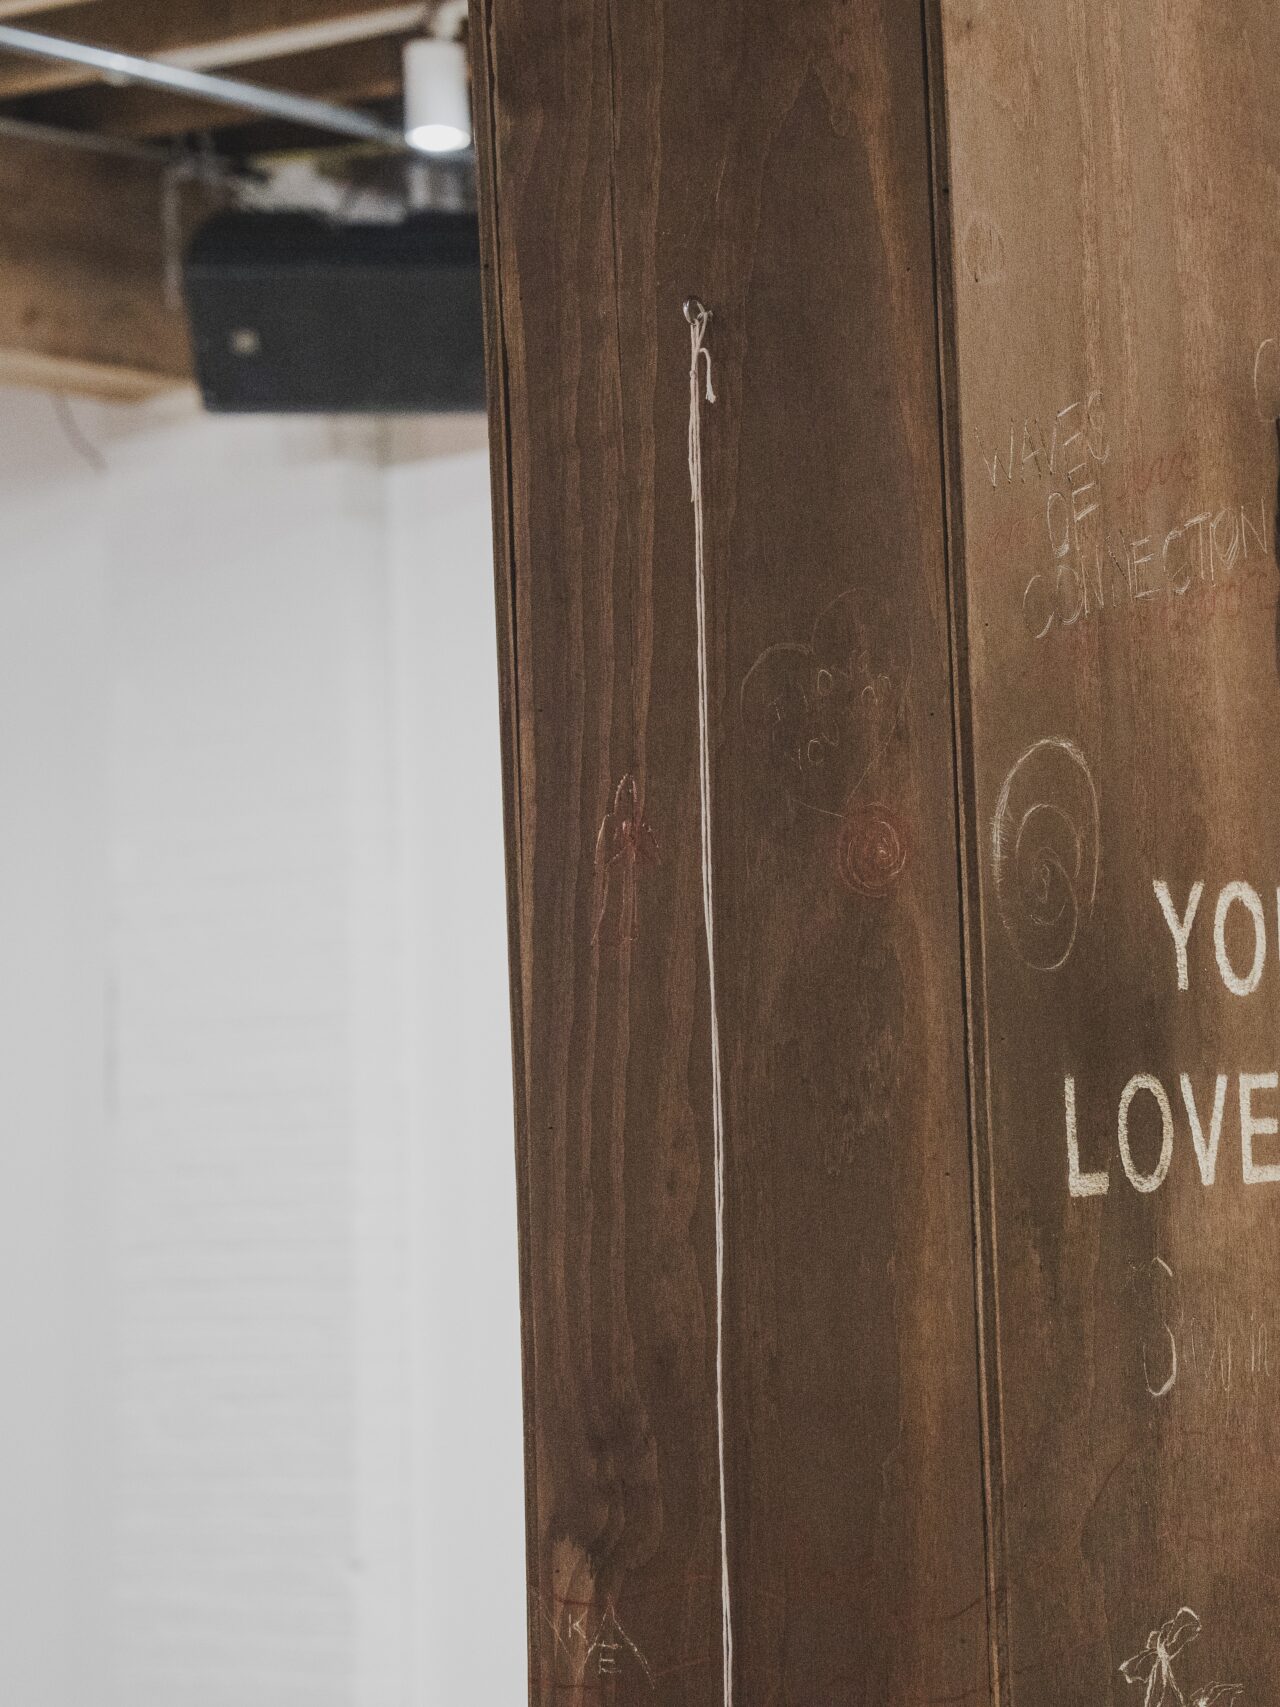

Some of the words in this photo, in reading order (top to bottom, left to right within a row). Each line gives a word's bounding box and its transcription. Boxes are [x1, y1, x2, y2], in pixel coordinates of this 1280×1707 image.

[974, 389, 1110, 491] WAVES
[1022, 496, 1268, 640] CONNECTION
[1046, 480, 1100, 559] OF
